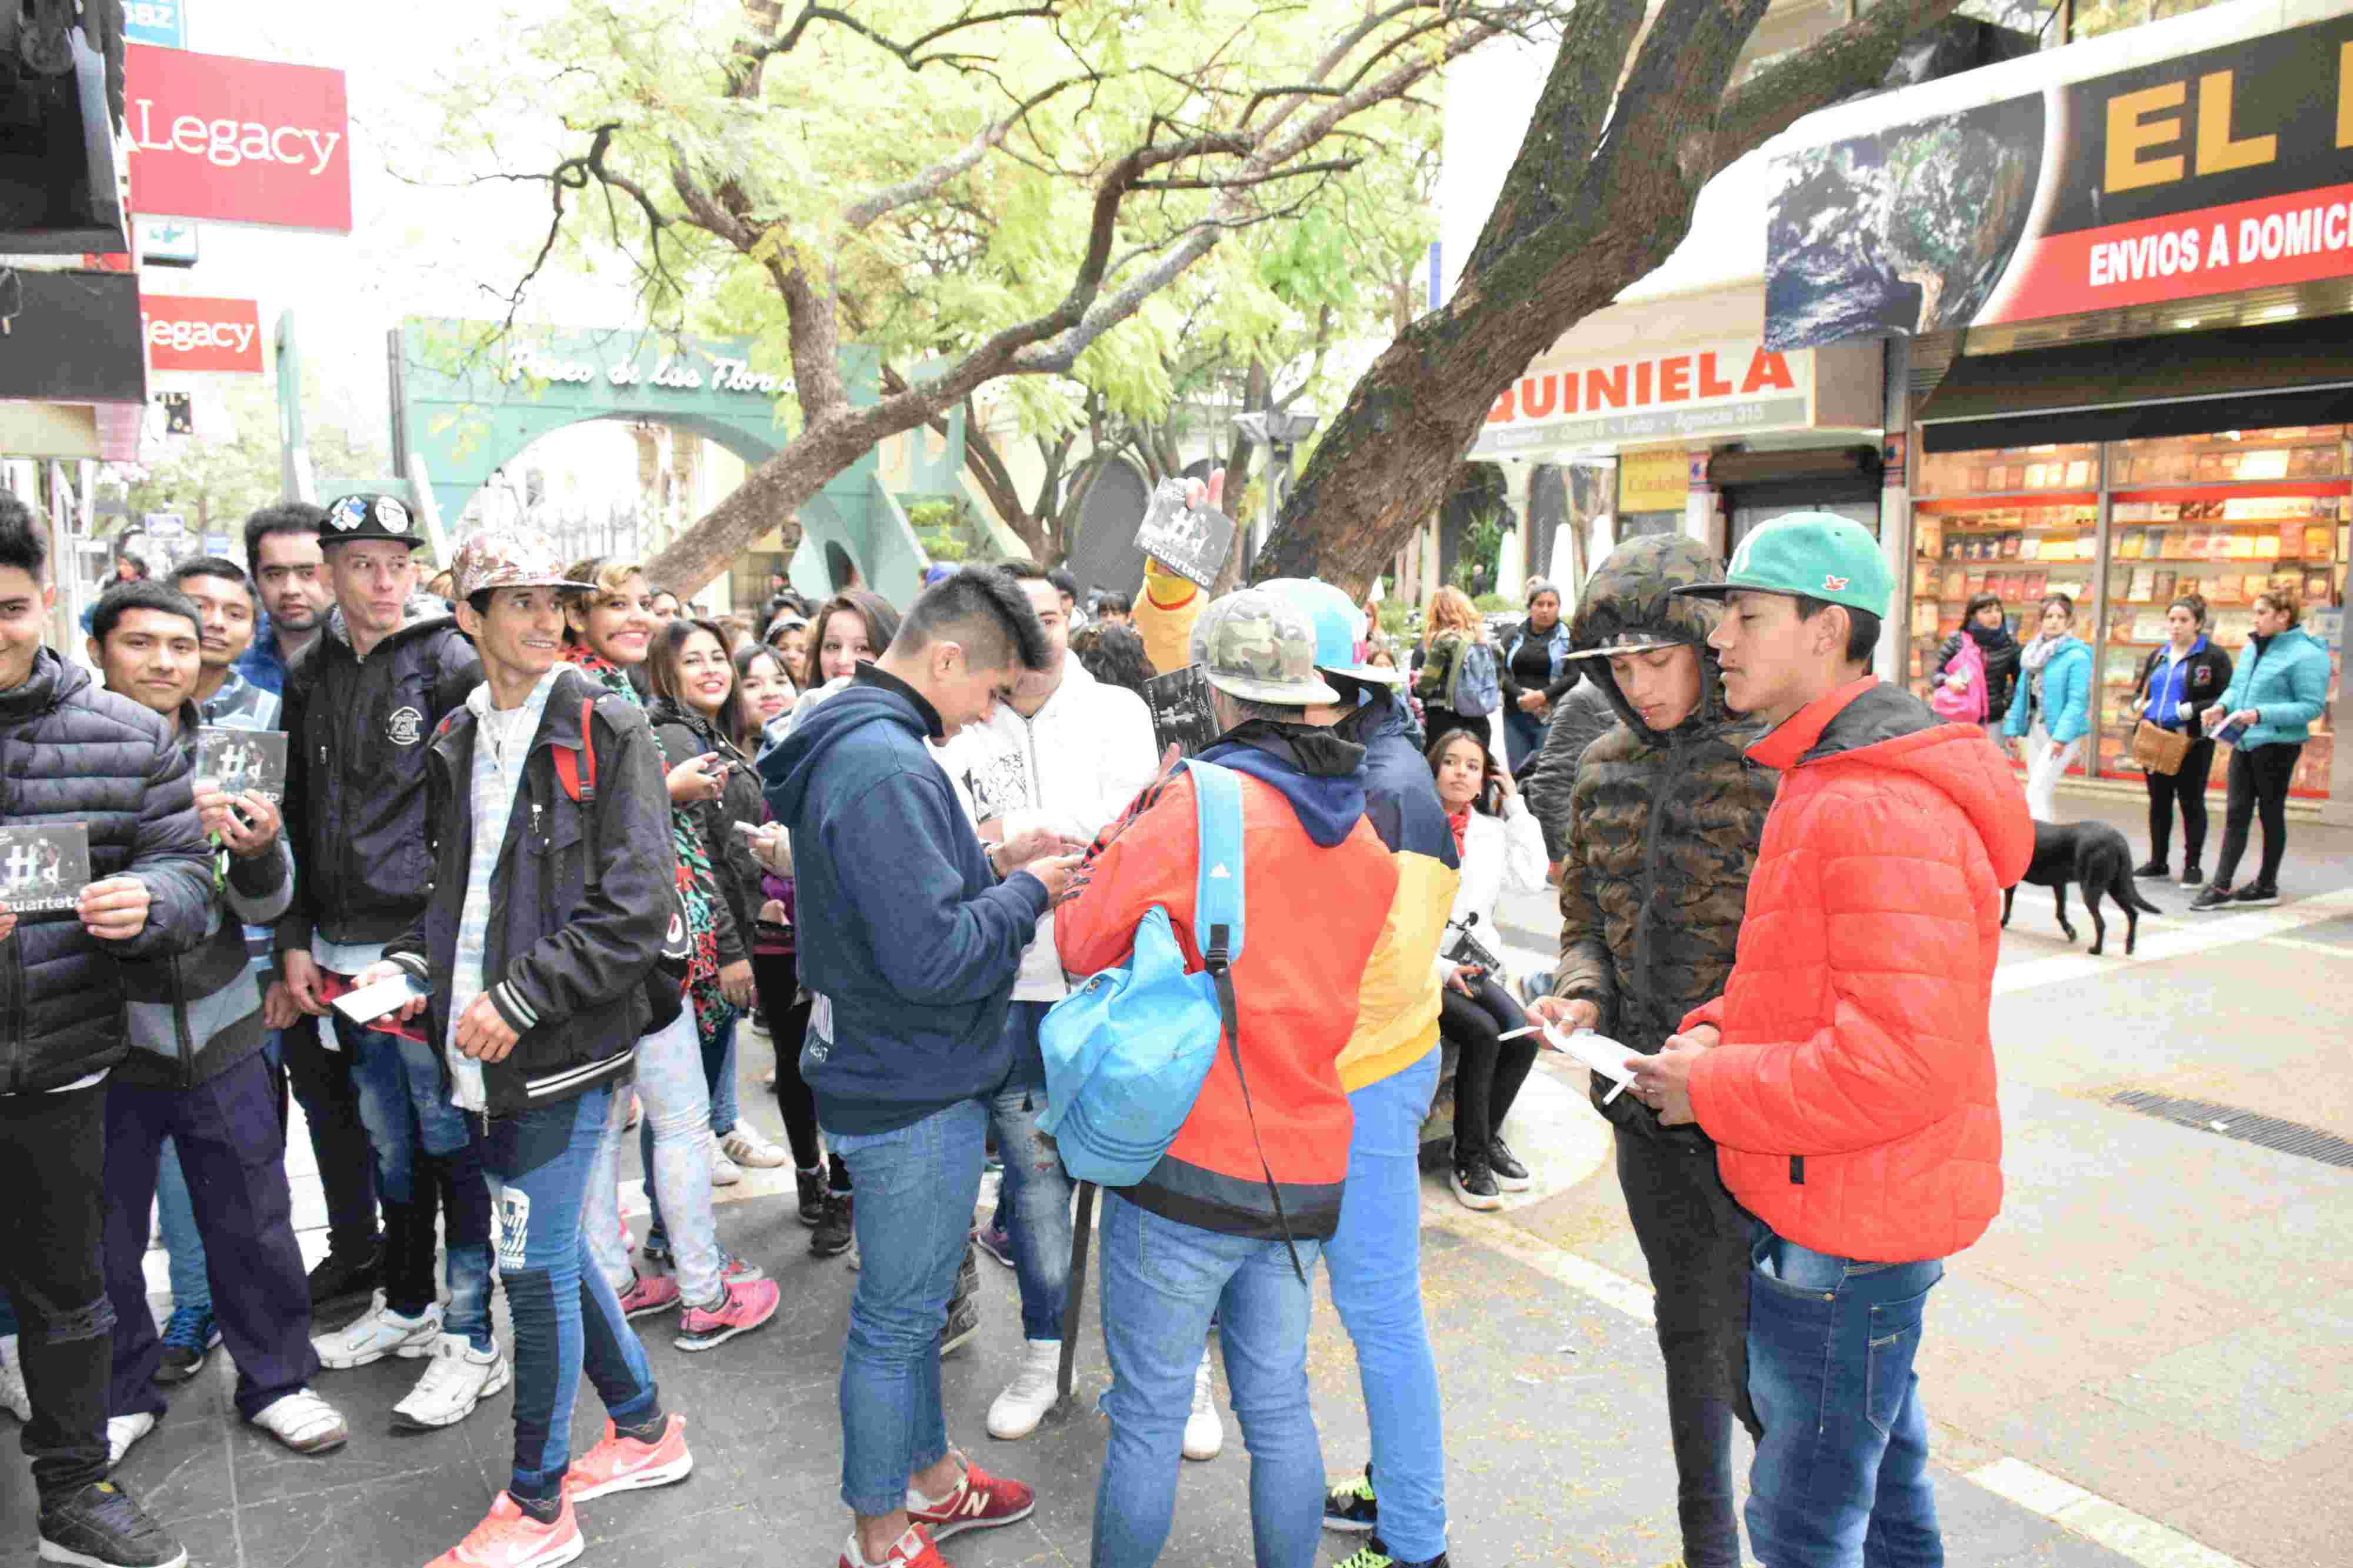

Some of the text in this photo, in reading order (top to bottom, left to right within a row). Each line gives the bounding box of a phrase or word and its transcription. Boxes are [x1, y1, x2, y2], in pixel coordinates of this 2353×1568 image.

[136, 99, 339, 175] Legacy
[2104, 68, 2277, 194] EL
[2089, 228, 2199, 286] ENVIOS
[2206, 223, 2230, 269] A
